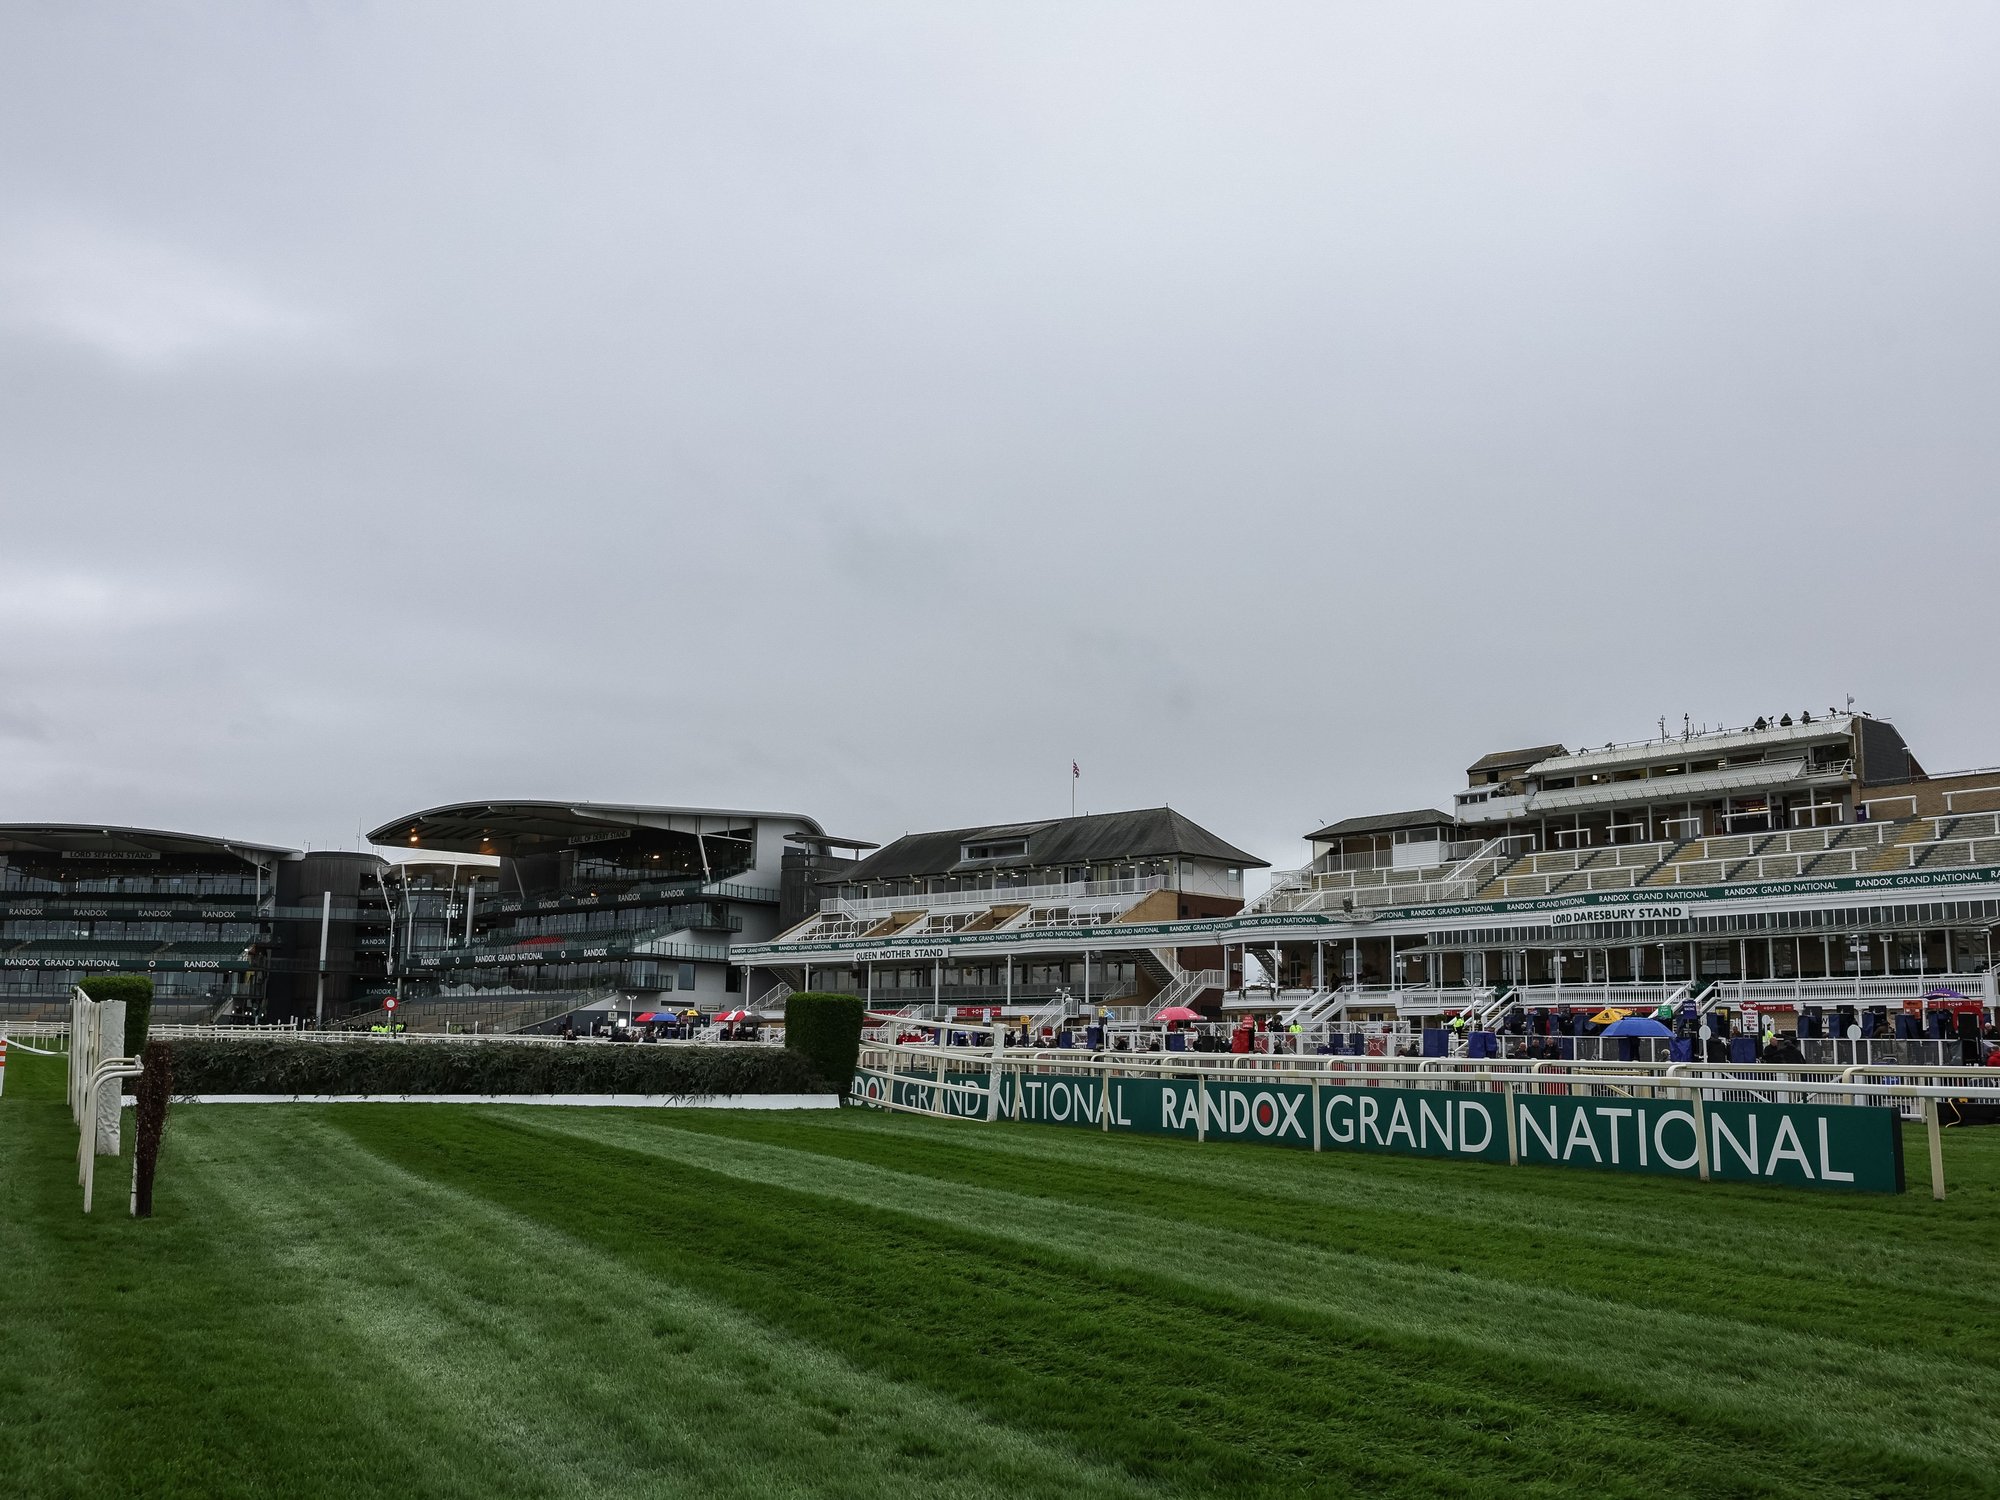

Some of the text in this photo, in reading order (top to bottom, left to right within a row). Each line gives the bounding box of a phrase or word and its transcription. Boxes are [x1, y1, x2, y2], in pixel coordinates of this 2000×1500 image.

[1855, 878, 1893, 888] RANDOX
[1896, 875, 1931, 886] GRAND
[1933, 871, 1982, 883] NATIONAL
[660, 888, 685, 899] RANDOX
[1724, 881, 1837, 897] RANDOX GRAND NATIONAL
[618, 893, 641, 902] RANDOX
[1598, 889, 1709, 903] RANDOX GRAND NATIONAL
[539, 900, 560, 909] RANDOX
[577, 897, 599, 906] RANDOX
[1506, 896, 1587, 912] RANDOX GRAND NATIONAL
[8, 908, 43, 916] RANDOX
[502, 903, 522, 913] RANDOX
[1410, 904, 1494, 917] RANDOX GRAND NATIONAL
[73, 909, 108, 917] RANDOX
[138, 910, 172, 918] RANDOX
[202, 910, 236, 918] RANDOX
[1552, 906, 1682, 925] LORD DARESBURY STAND
[1239, 915, 1317, 926] RANDOX GRAND NATIONAL
[1114, 928, 1132, 936] GRAND
[1133, 926, 1160, 935] NATIONAL
[1169, 924, 1191, 933] RANDOX
[1192, 923, 1212, 931] GRAND
[979, 934, 995, 942] GRAND
[995, 933, 1018, 941] NATIONAL
[1035, 931, 1054, 939] GRAND
[1055, 930, 1083, 938] NATIONAL
[855, 941, 870, 949] GRAND
[892, 937, 951, 946] RANDOX GRAND NATIONAL
[779, 943, 832, 952] RANDOX GRAND NATIONAL
[583, 948, 608, 957] RANDOX
[856, 948, 943, 961] QUEEN MOTHER STAND
[421, 958, 441, 966] RANDOX
[475, 952, 543, 964] RANDOX GRAND NATIONAL
[4, 958, 120, 968] RANDOX GRAND NATIONAL
[184, 960, 220, 968] RANDOX
[902, 1079, 982, 1116] GRAND
[997, 1081, 1132, 1126] NATIONAL
[1162, 1087, 1307, 1139] RANDOX
[1325, 1093, 1494, 1153] GRAND
[1520, 1103, 1855, 1182] NATIONAL
